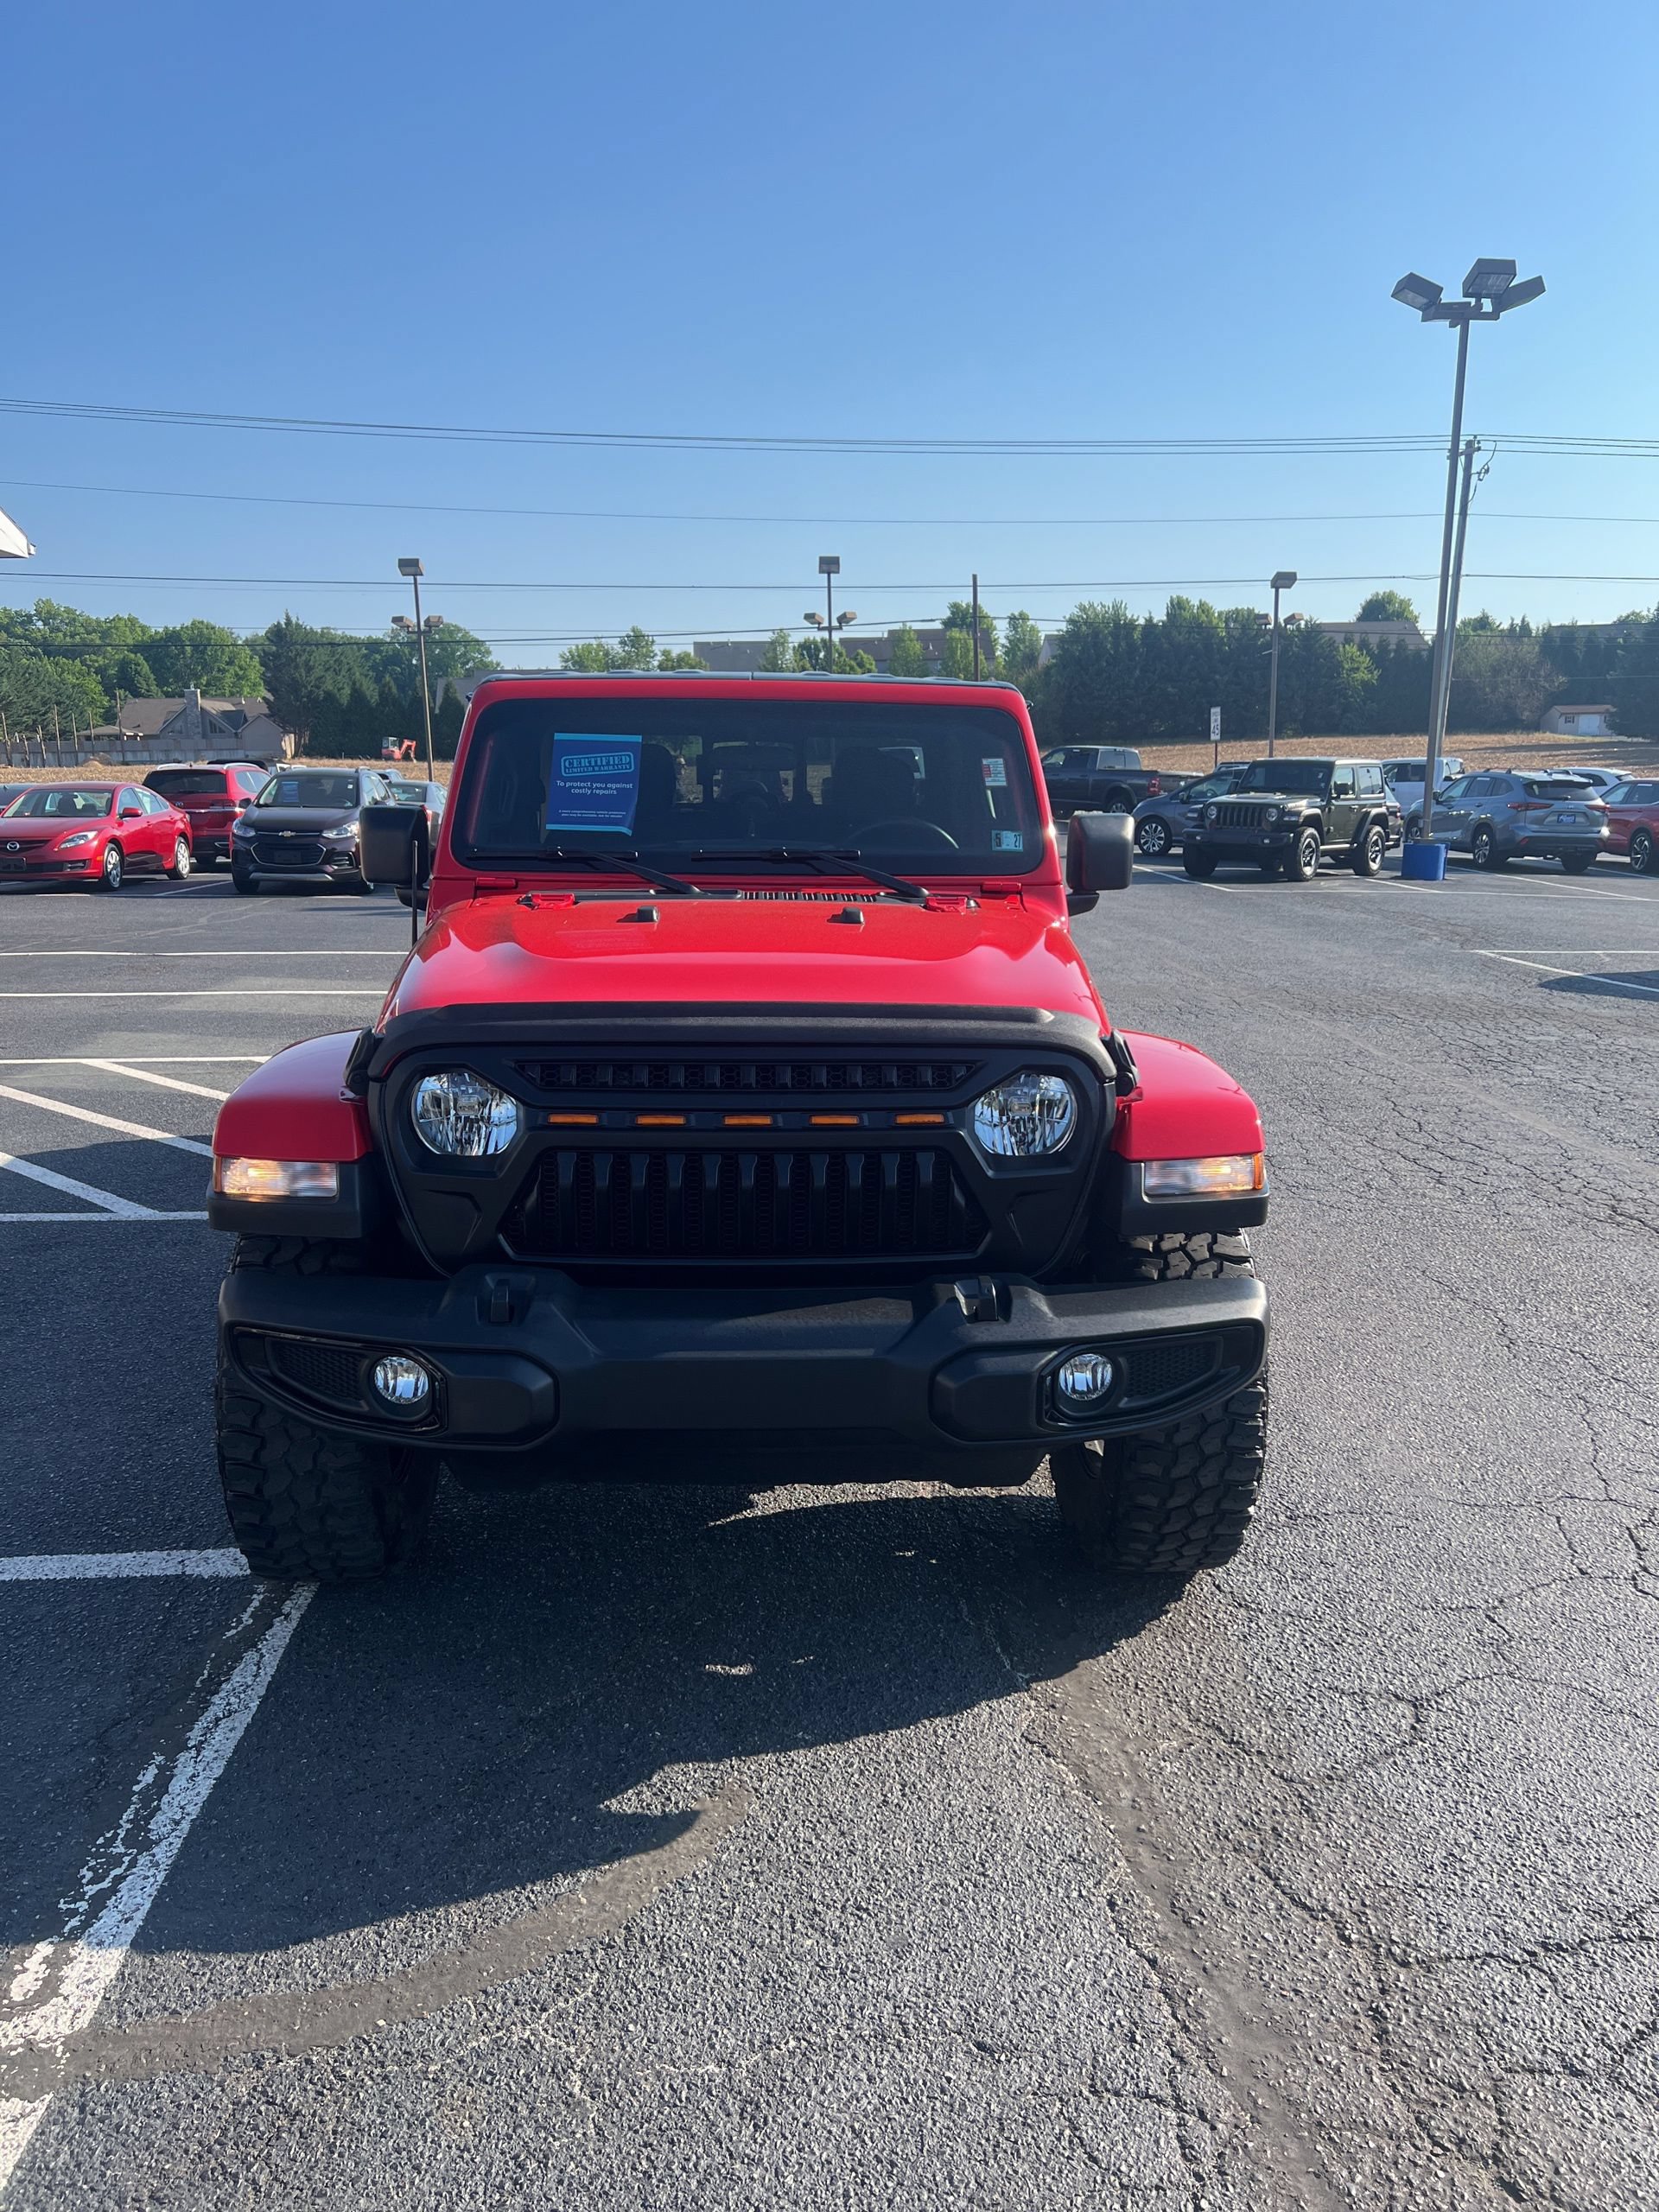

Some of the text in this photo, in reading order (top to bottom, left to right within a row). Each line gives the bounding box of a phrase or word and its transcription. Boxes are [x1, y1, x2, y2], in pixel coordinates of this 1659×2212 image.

[1211, 724, 1219, 736] 45
[565, 755, 630, 768] CERTIFIED
[995, 832, 1002, 848] 5
[1014, 833, 1021, 848] 27
